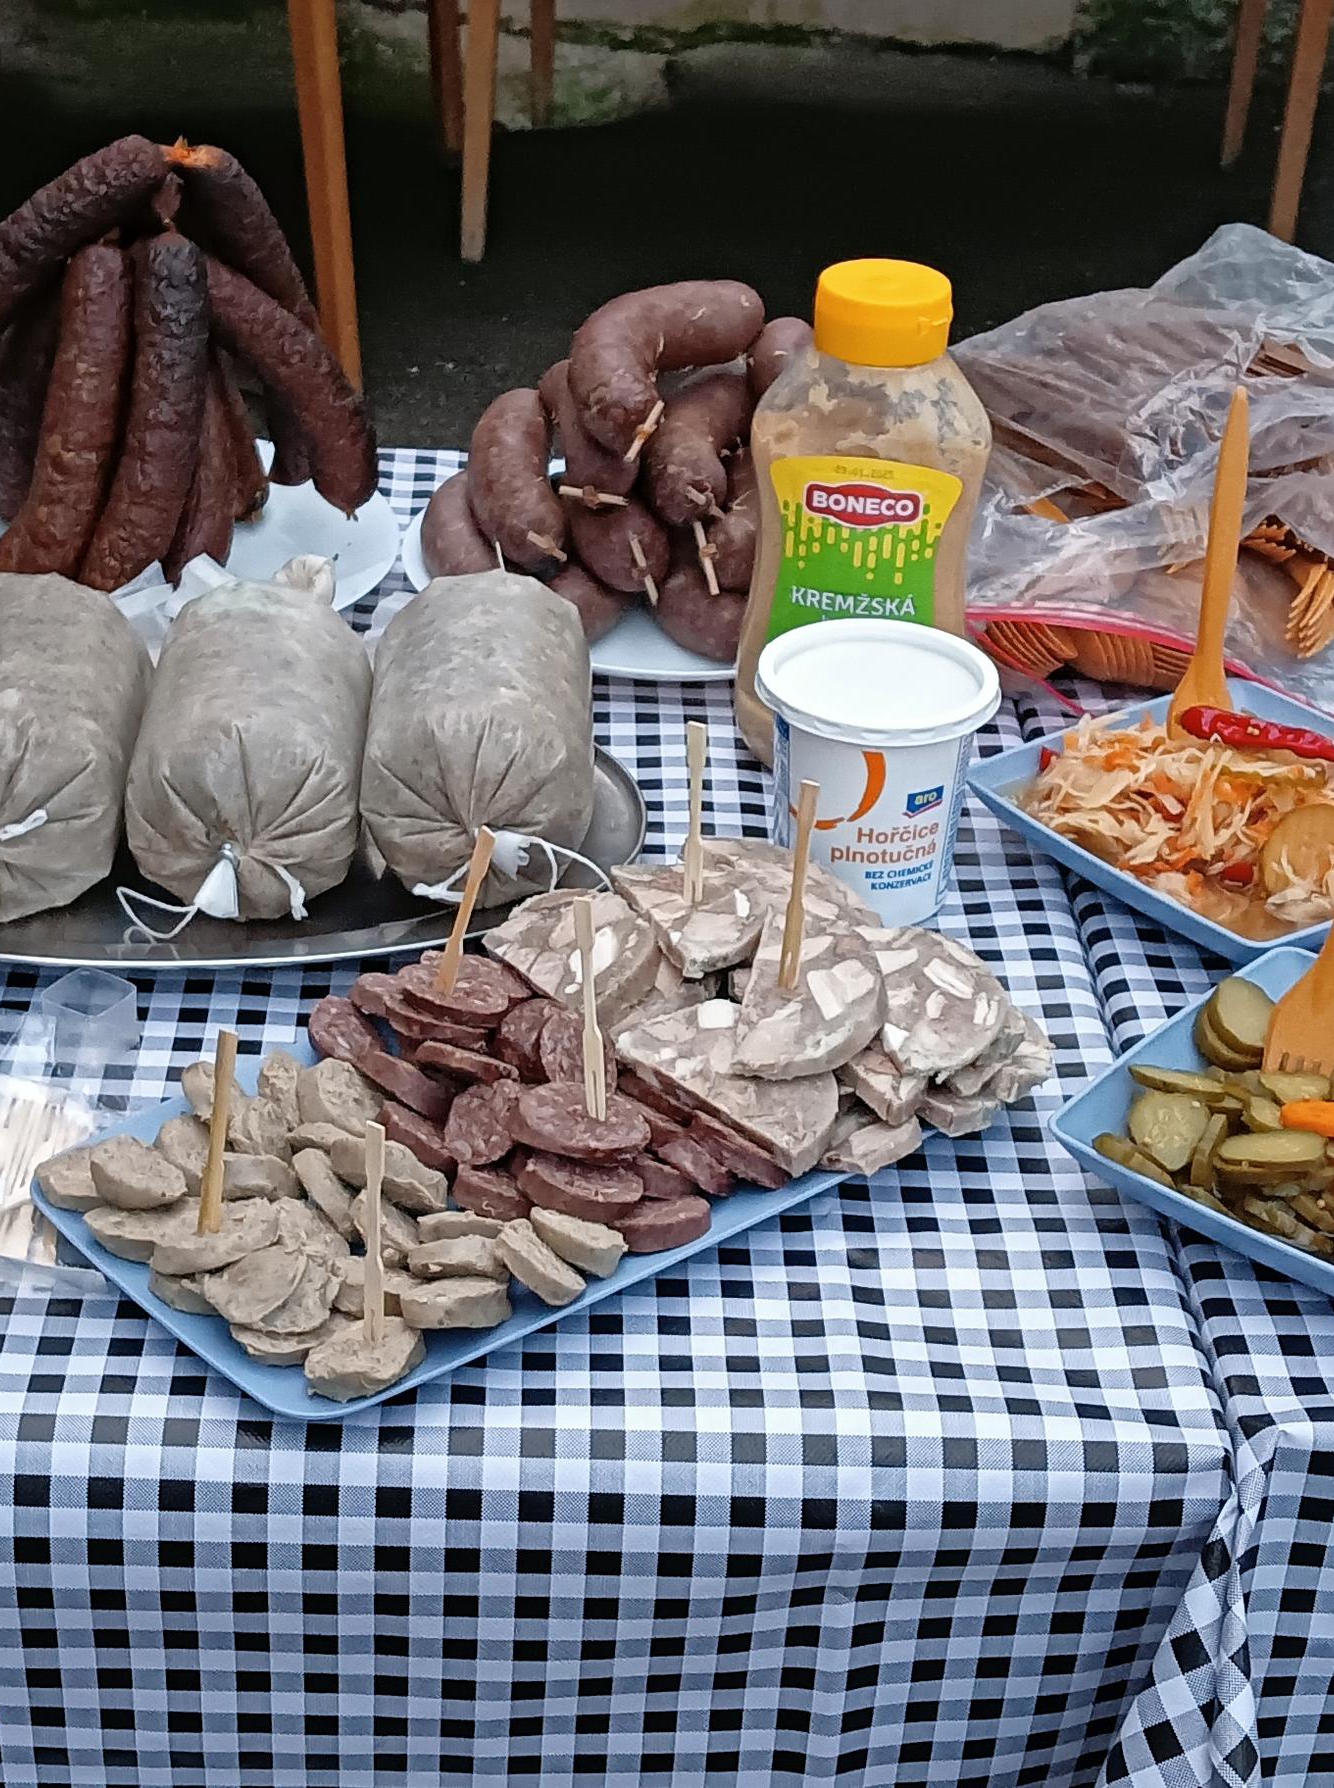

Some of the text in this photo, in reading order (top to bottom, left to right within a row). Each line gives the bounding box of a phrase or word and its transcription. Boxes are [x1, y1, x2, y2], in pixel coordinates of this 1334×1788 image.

[812, 491, 914, 517] BONECO
[791, 585, 916, 616] KREMŽSKÁ
[914, 791, 937, 805] aro
[857, 821, 940, 844] Hořčice
[831, 838, 937, 864] plnotučná
[865, 871, 884, 879] BEZ
